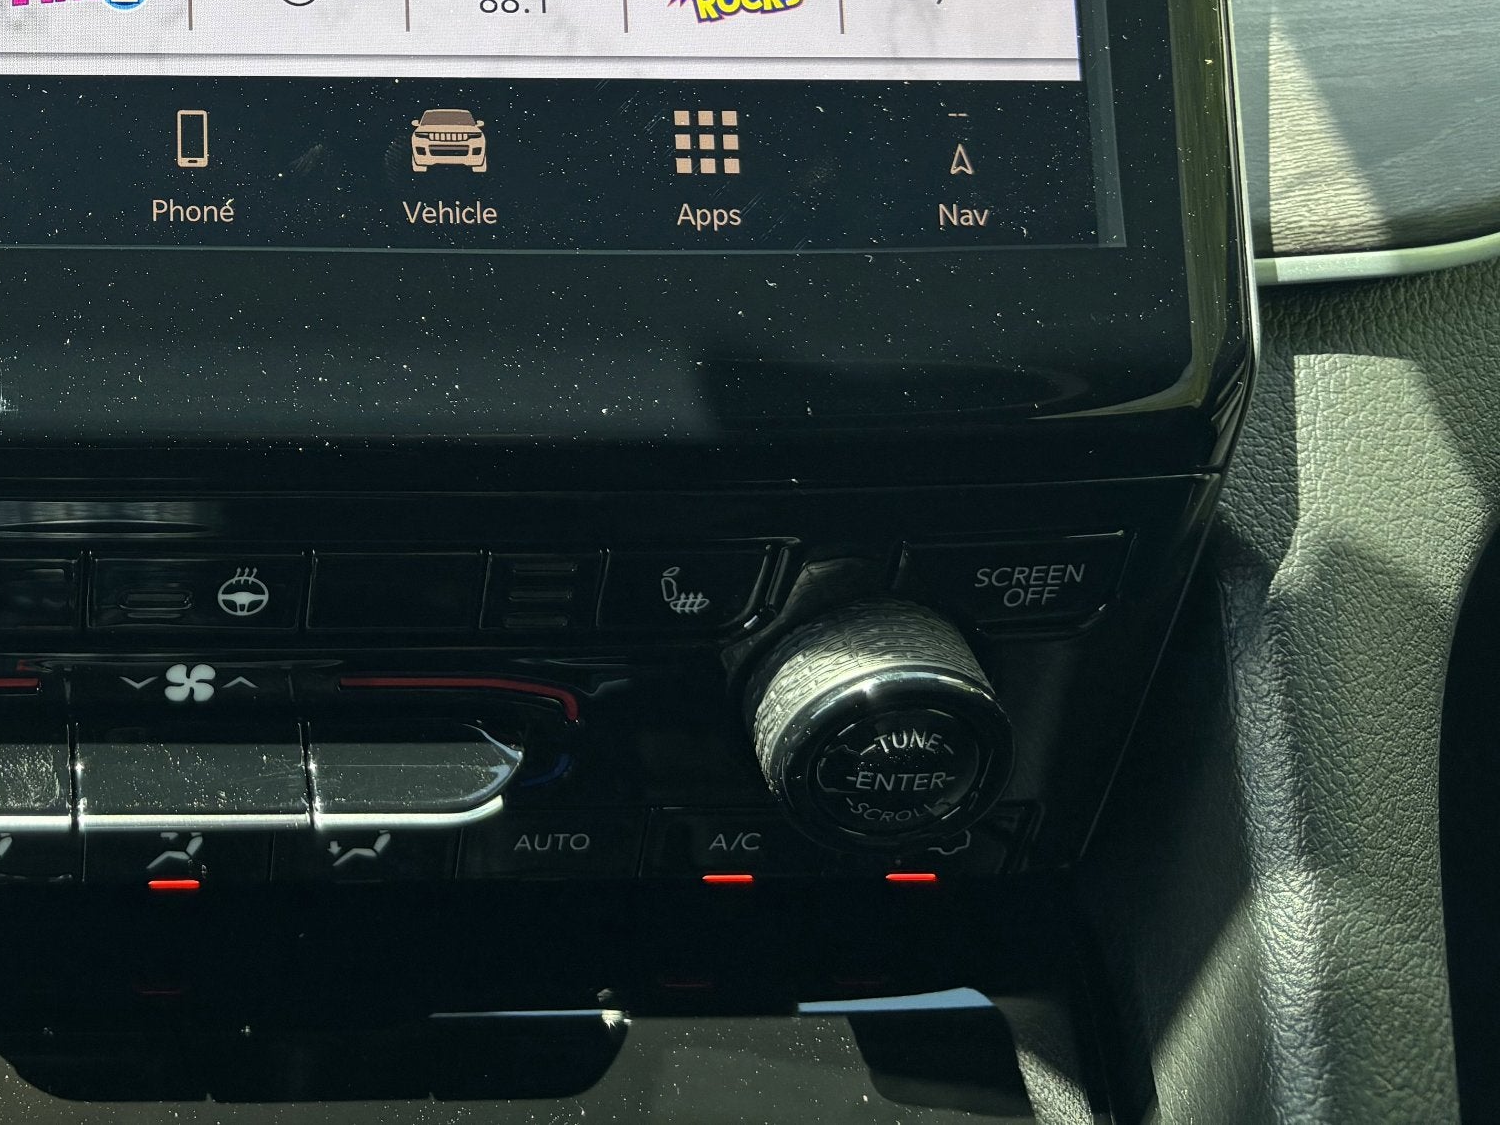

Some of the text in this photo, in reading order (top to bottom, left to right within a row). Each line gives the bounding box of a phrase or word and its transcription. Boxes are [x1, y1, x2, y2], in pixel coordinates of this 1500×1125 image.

[151, 198, 235, 223] Phone
[402, 200, 497, 227] Vehicle
[676, 201, 742, 232] Apps
[938, 203, 990, 228] Nav
[975, 563, 1085, 589] SCREEN
[1003, 585, 1057, 607] OFF
[874, 729, 942, 753] TUNE
[855, 771, 946, 791] ENTER
[514, 832, 590, 852] AUTO
[709, 832, 761, 852] A/C
